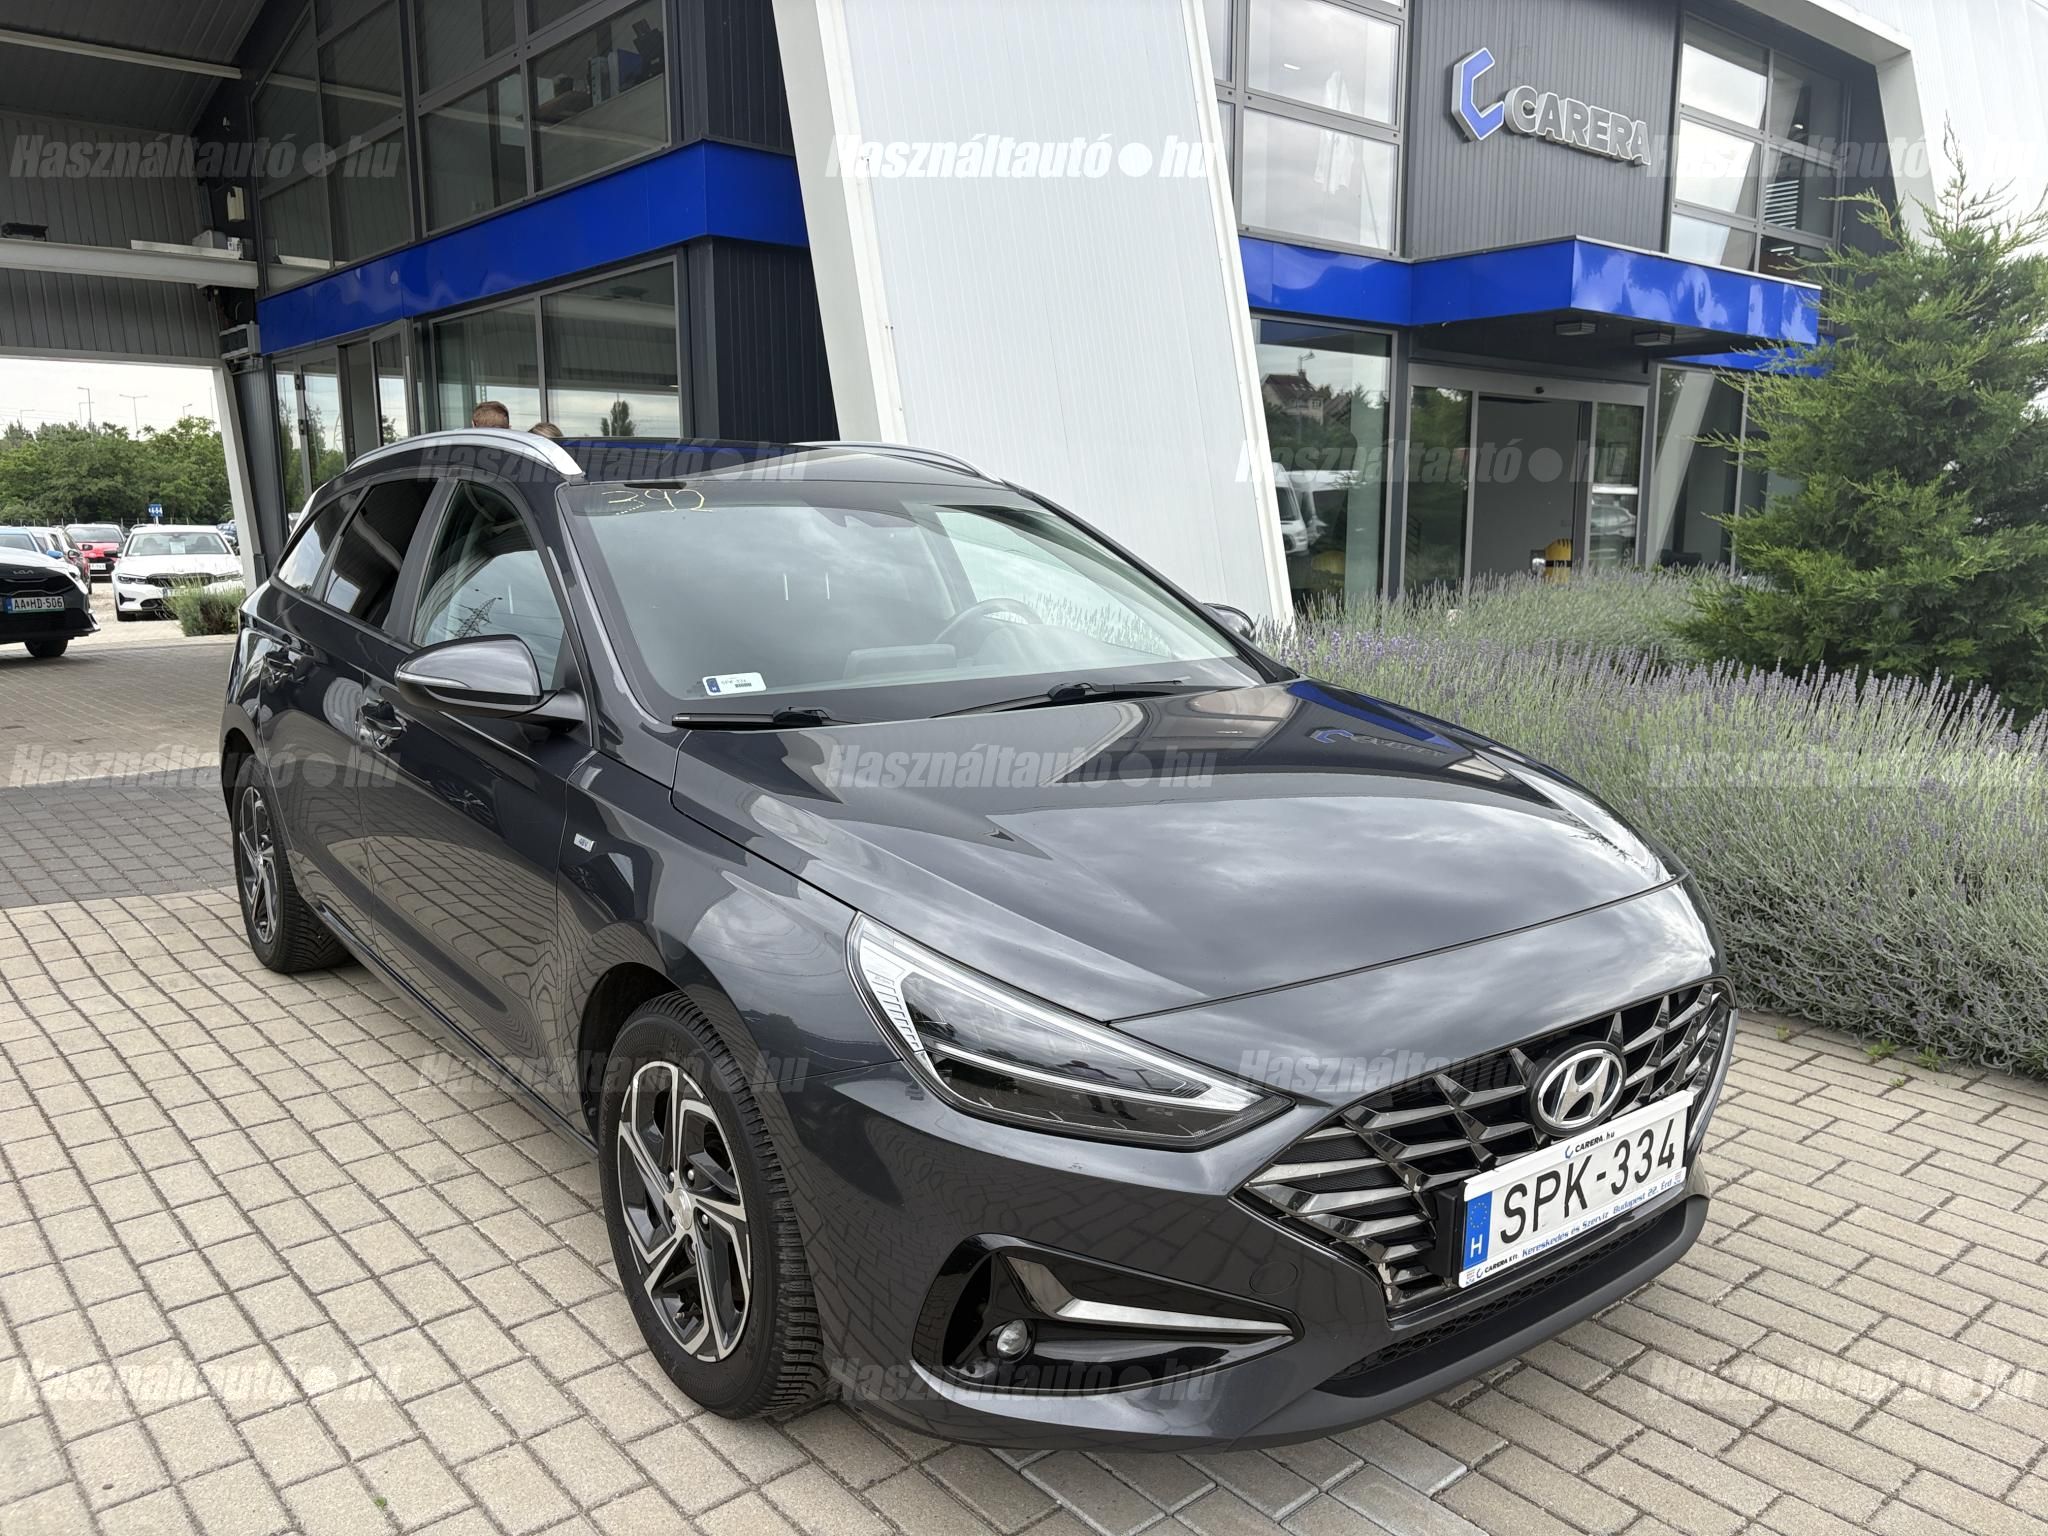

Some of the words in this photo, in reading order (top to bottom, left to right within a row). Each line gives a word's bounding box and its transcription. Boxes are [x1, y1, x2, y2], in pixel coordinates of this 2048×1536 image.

[1505, 85, 1651, 166] CARERA
[31, 597, 63, 609] HD-506
[1470, 1234, 1483, 1259] H
[1500, 1118, 1675, 1244] SPK-334
[1484, 1258, 1508, 1273] CARERA
[1582, 1210, 1609, 1230] Szerviz
[1612, 1193, 1645, 1214] Budapest
